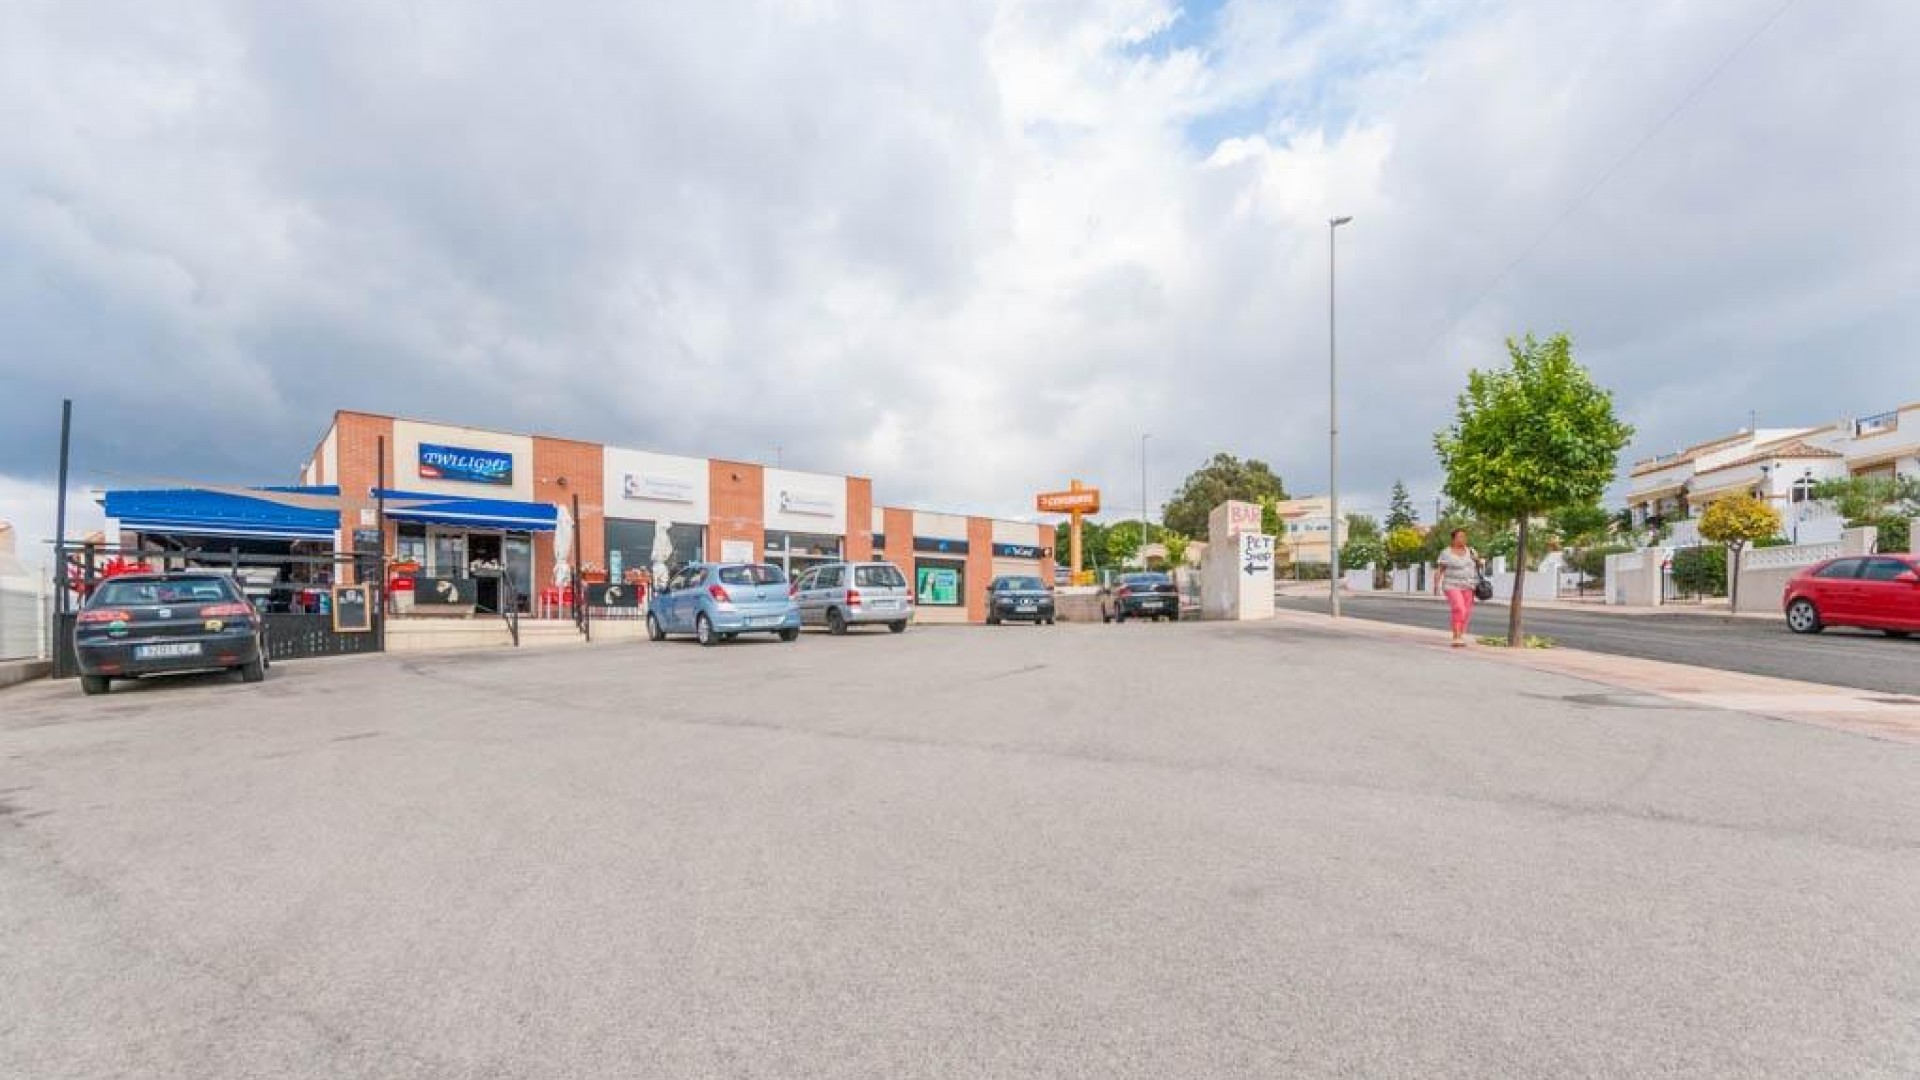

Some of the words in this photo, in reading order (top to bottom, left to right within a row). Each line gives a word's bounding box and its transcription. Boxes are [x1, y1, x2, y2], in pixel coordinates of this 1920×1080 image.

[423, 452, 509, 471] TWILIGHT
[1232, 507, 1260, 523] BAR
[1246, 535, 1271, 549] PET
